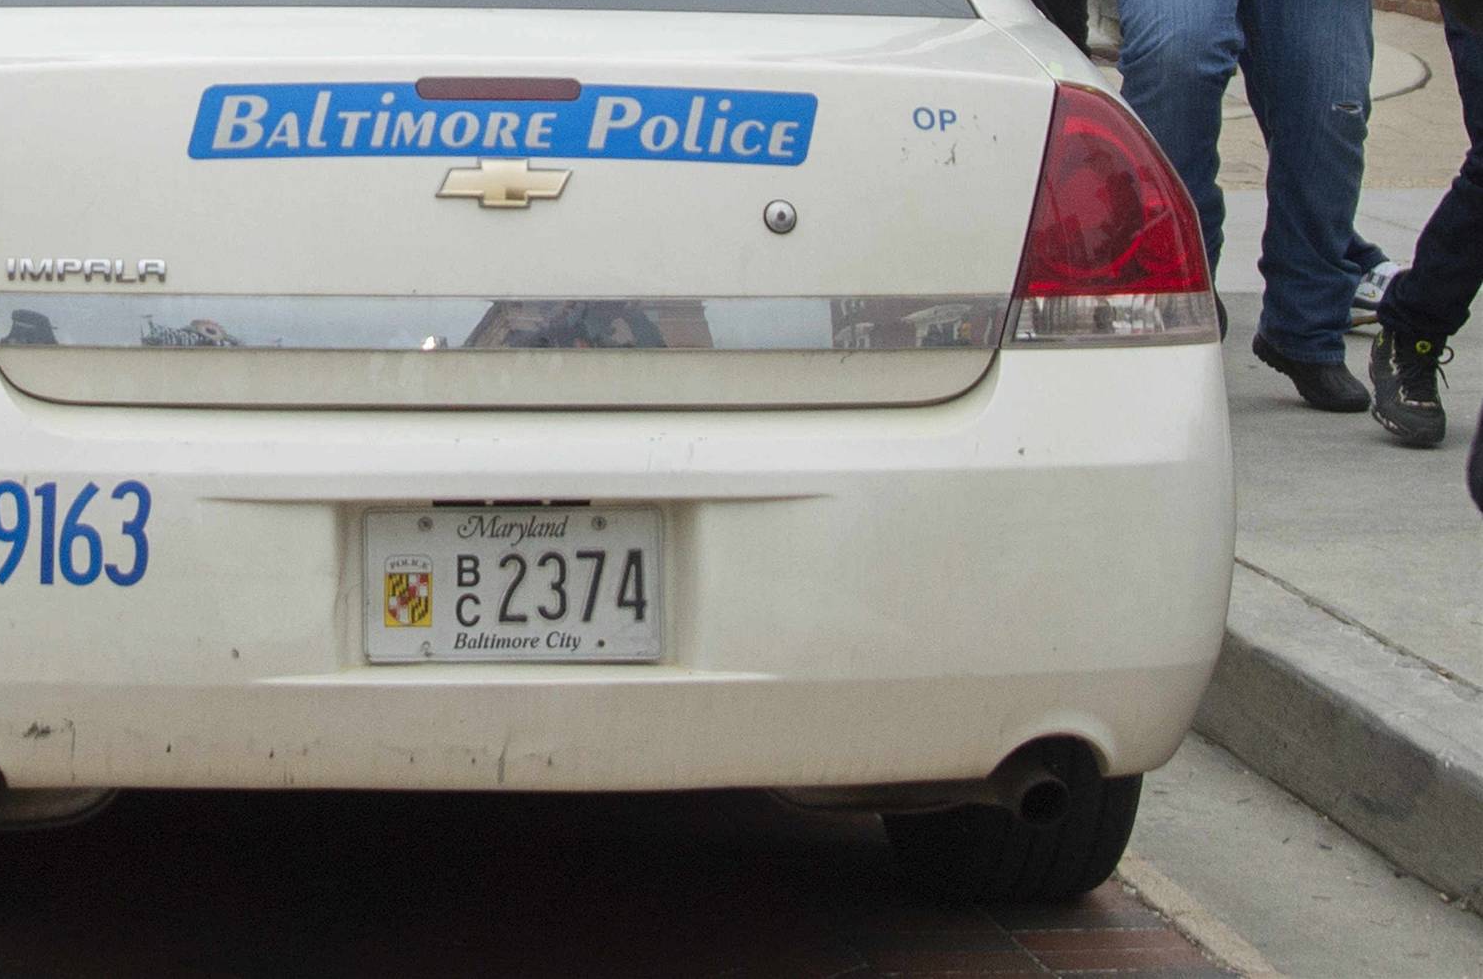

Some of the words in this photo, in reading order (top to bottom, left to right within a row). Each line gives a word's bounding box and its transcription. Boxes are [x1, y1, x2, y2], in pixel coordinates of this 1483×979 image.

[912, 105, 958, 133] OP
[6, 257, 168, 283] IMPALA
[456, 515, 569, 548] Maryland
[498, 548, 647, 623] 2374
[453, 632, 539, 650] Baltimore
[546, 631, 582, 650] City
